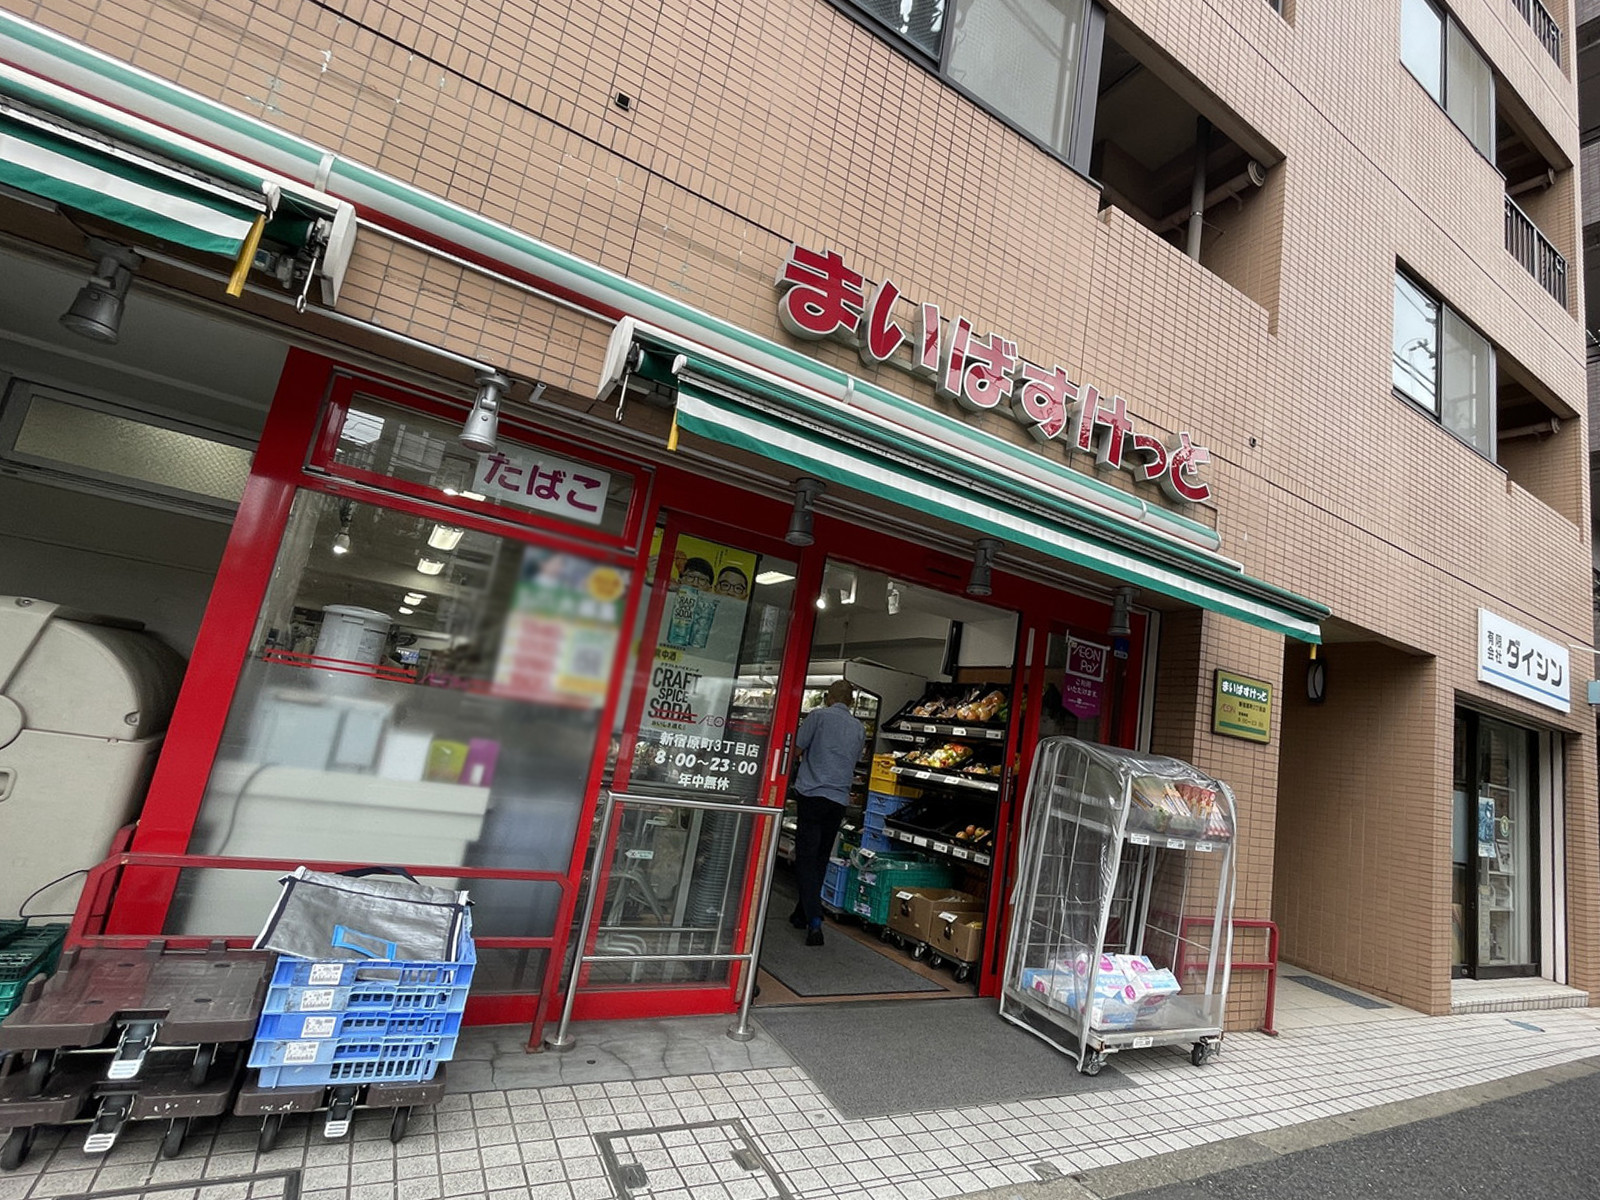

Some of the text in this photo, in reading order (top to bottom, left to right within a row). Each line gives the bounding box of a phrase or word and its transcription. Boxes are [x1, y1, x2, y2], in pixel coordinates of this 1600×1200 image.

[780, 243, 1211, 501] まいばすけっと
[484, 452, 601, 513] たばこ
[1506, 639, 1562, 687] ダイシン
[652, 667, 702, 695] CRAFT
[1221, 680, 1268, 702] まいばすけっと
[658, 687, 689, 703] SPICE
[648, 698, 693, 722] SODA
[660, 731, 760, 758] 新宿原町3丁目店
[677, 772, 730, 791] 年中無休
